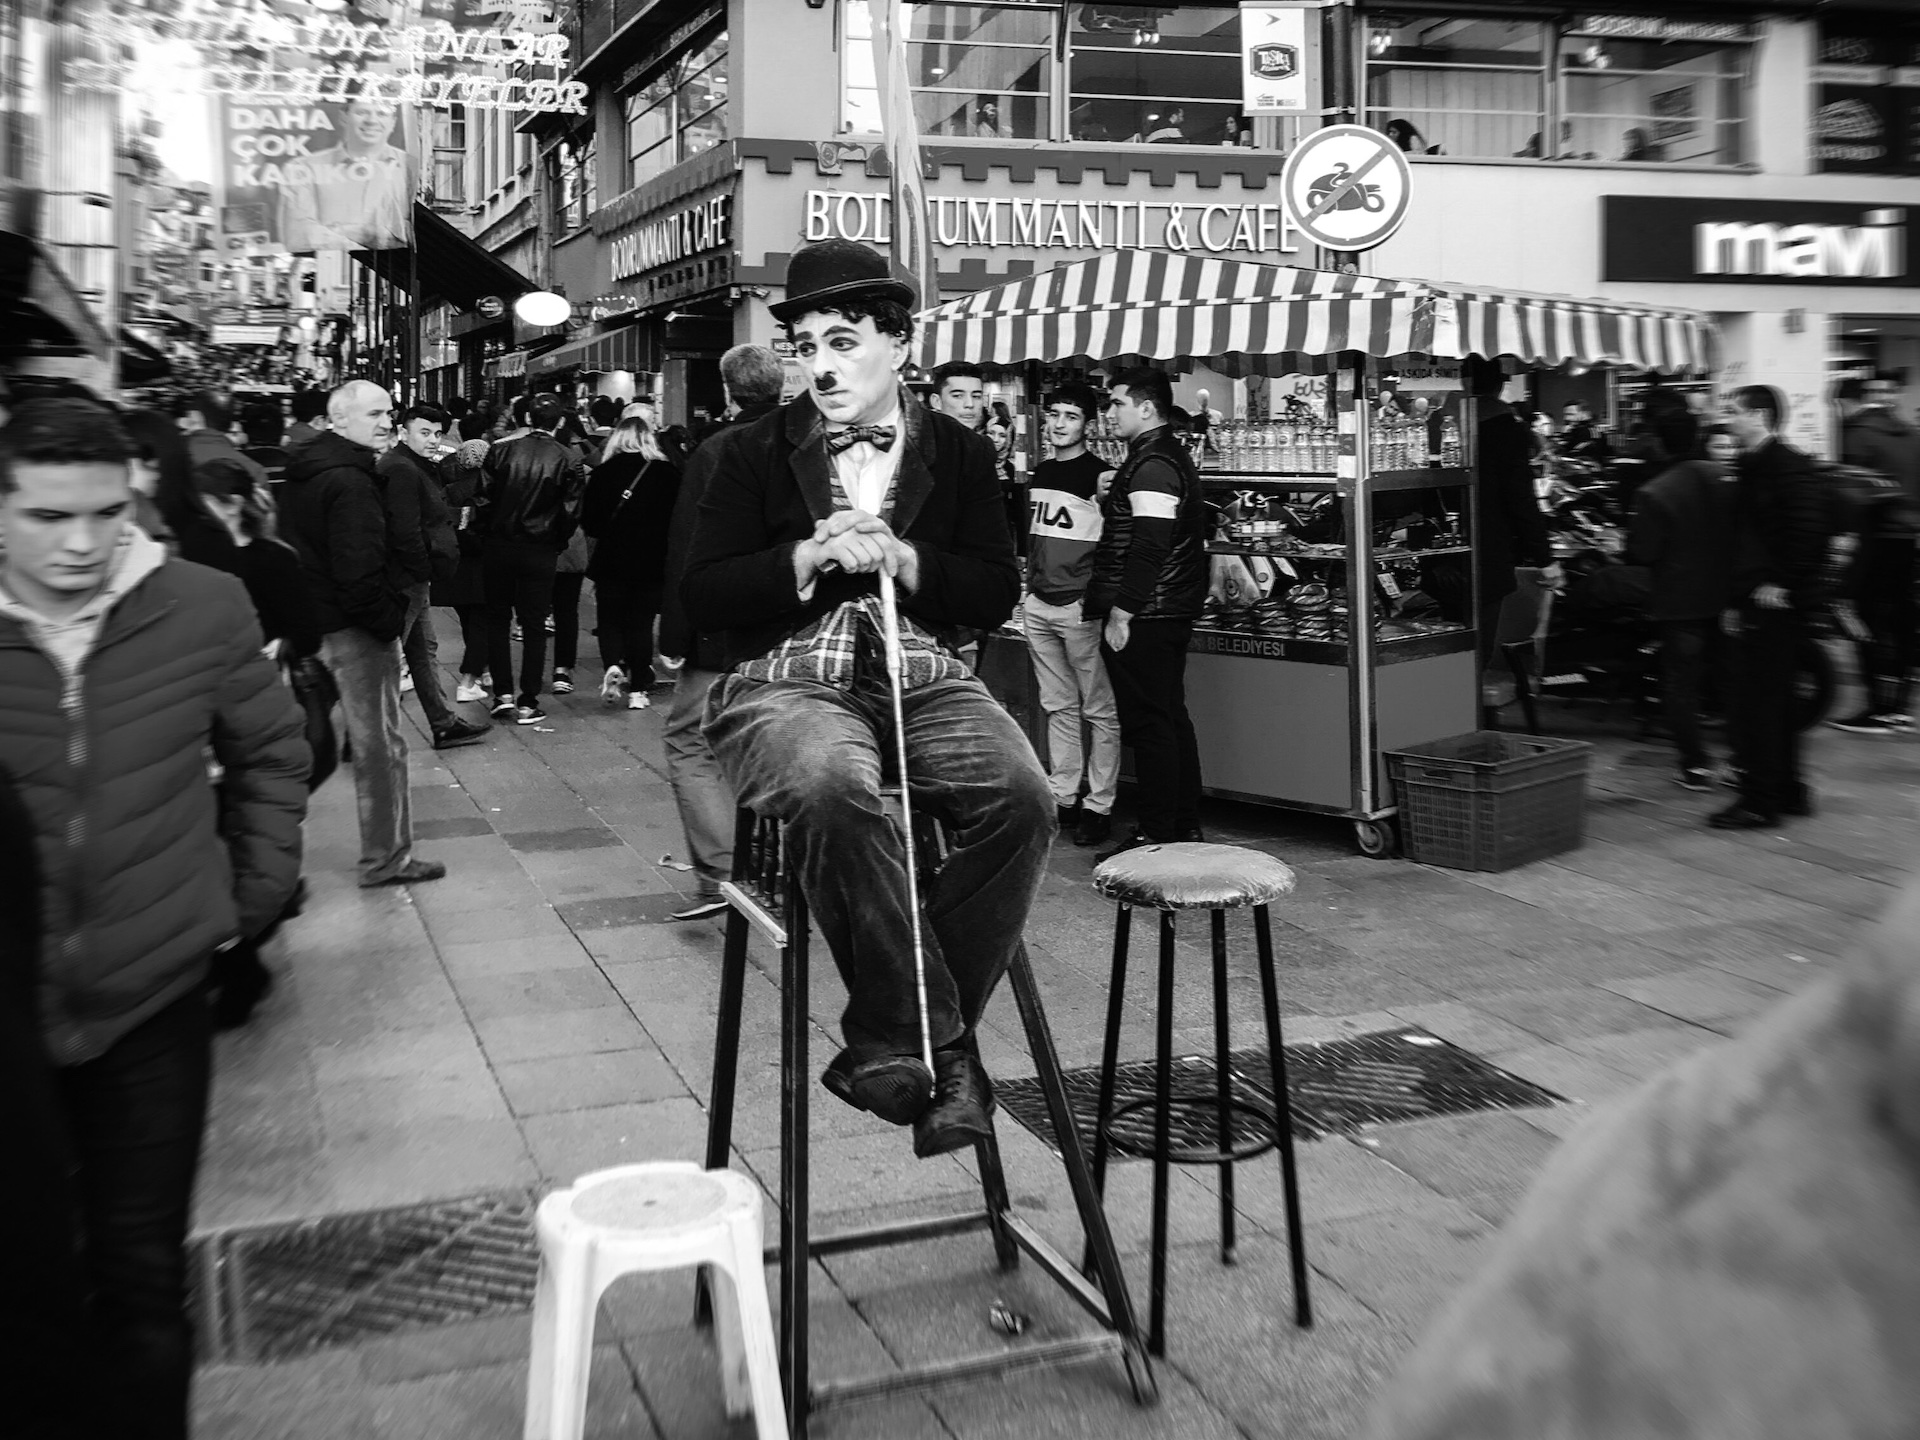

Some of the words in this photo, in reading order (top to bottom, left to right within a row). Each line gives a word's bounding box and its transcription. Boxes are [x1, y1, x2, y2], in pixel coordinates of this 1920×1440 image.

[228, 107, 336, 131] DAHA
[230, 134, 313, 163] ÇOK
[694, 194, 726, 252] CAFE
[1010, 196, 1147, 250] MANTI
[1166, 201, 1191, 252] &
[1200, 203, 1299, 253] CAFE
[1694, 208, 1907, 278] mavi
